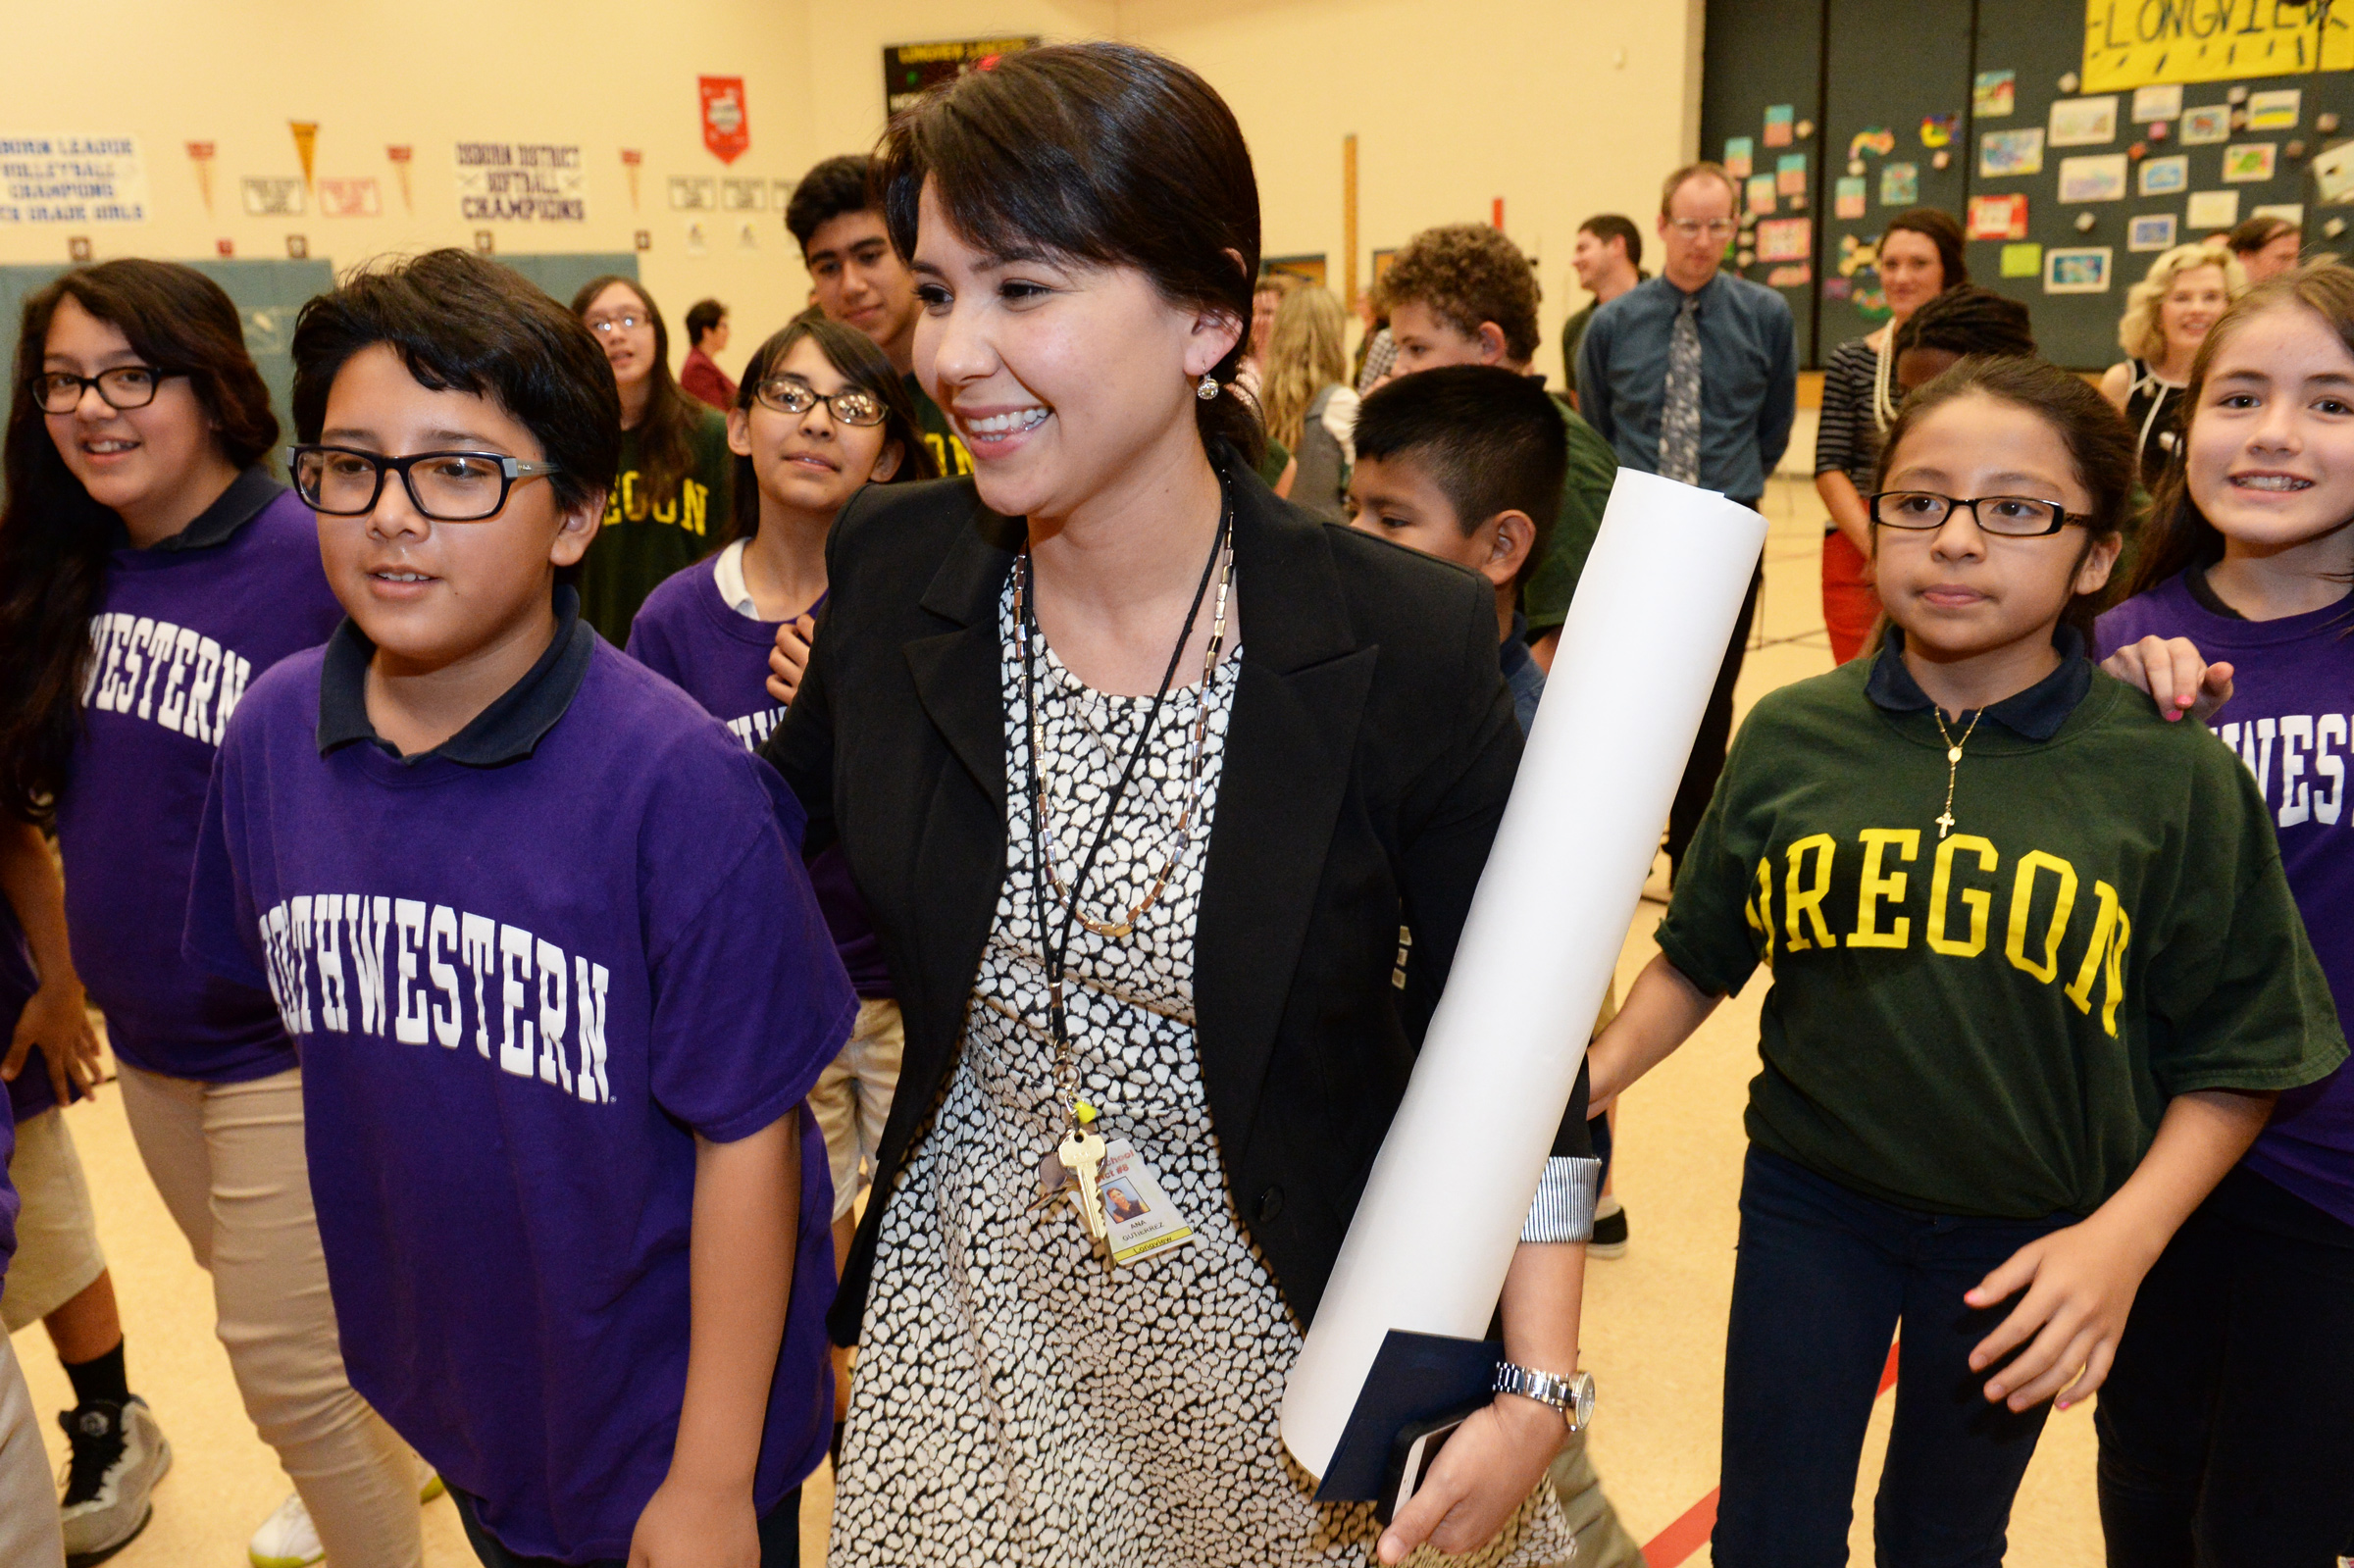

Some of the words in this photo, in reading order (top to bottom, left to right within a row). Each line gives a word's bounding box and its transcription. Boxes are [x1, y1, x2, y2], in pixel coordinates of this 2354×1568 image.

[461, 196, 585, 221] CHAMPIONS
[1105, 1149, 1135, 1167] chool
[1122, 1221, 1164, 1241] GUTIERREZ
[1130, 1219, 1147, 1230] ANA
[1133, 1236, 1172, 1254] Longview
